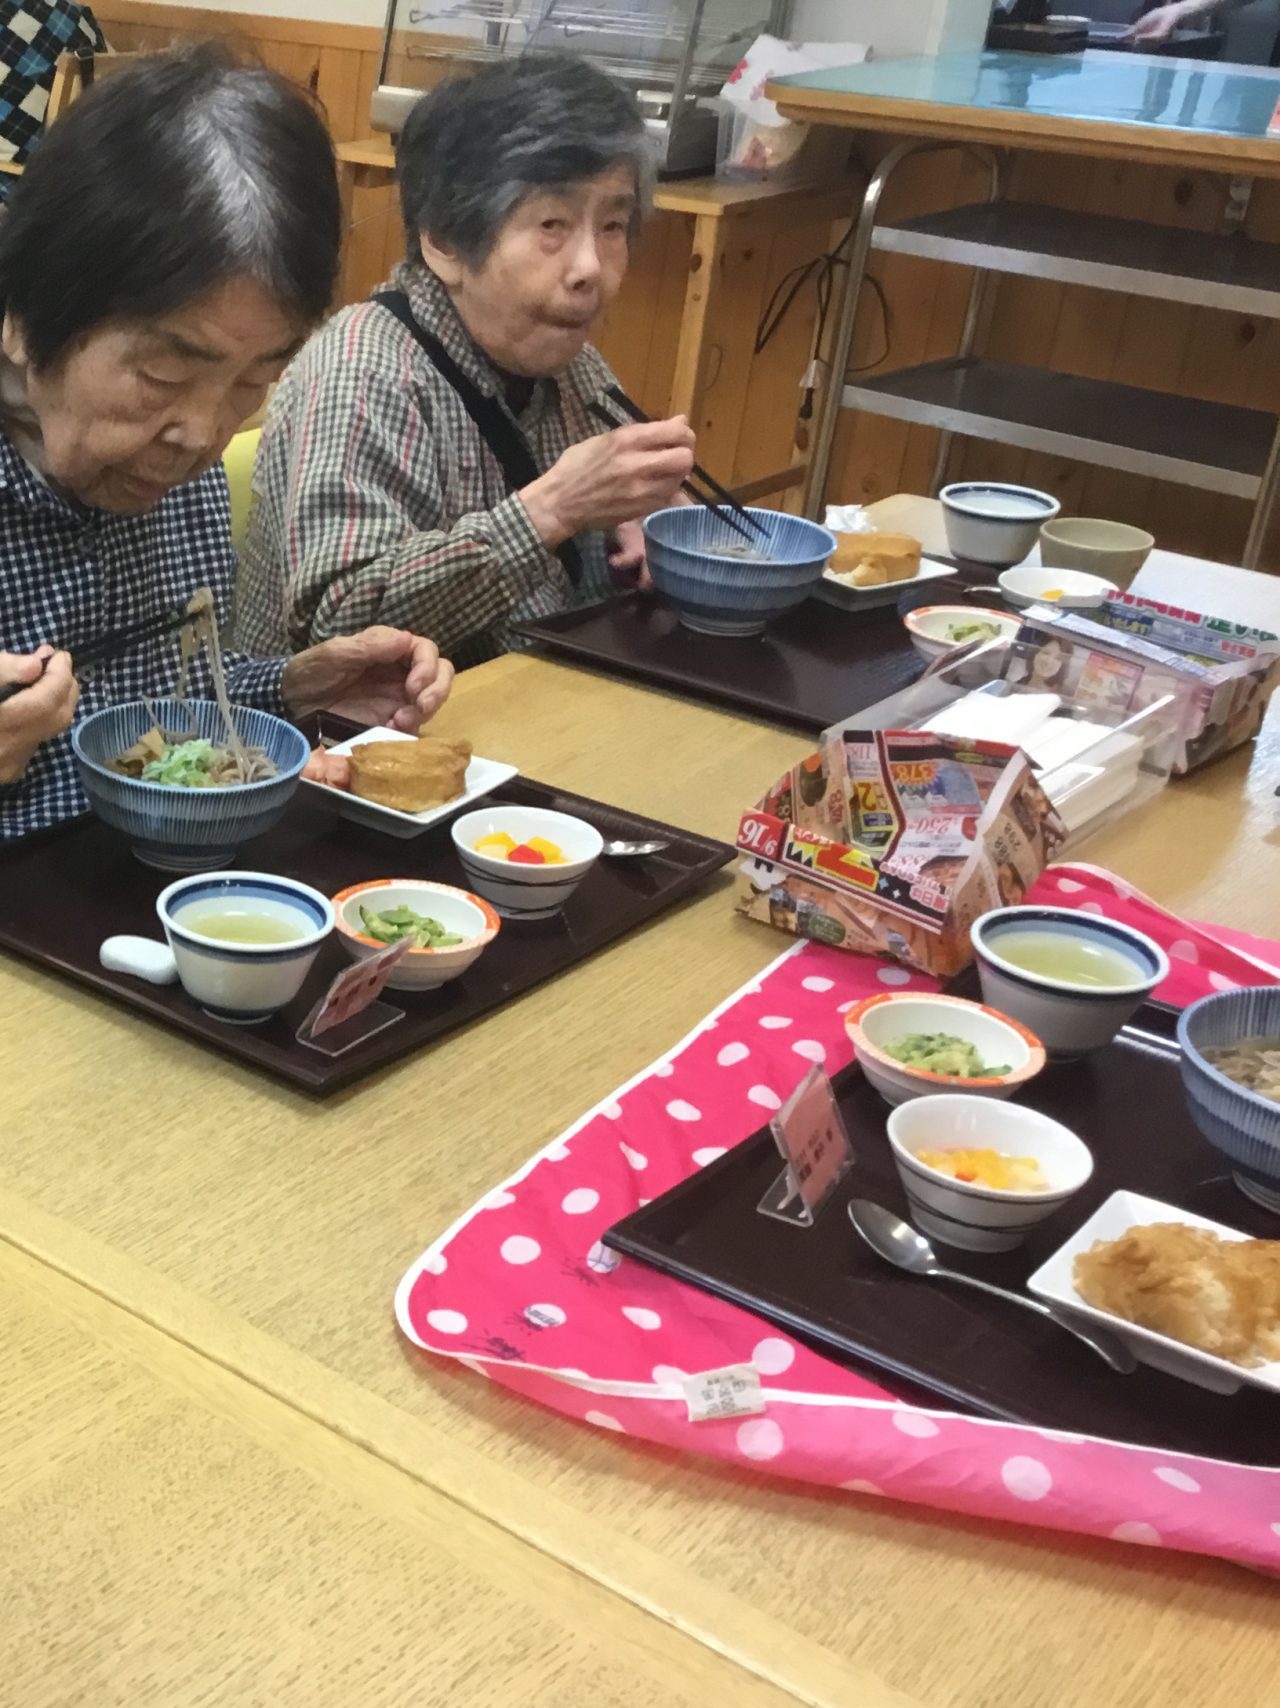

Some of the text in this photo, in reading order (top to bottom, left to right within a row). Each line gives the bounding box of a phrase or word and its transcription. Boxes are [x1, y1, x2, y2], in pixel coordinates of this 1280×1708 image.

[896, 764, 931, 782] 378
[916, 817, 952, 834] 250
[738, 819, 779, 857] 9/16
